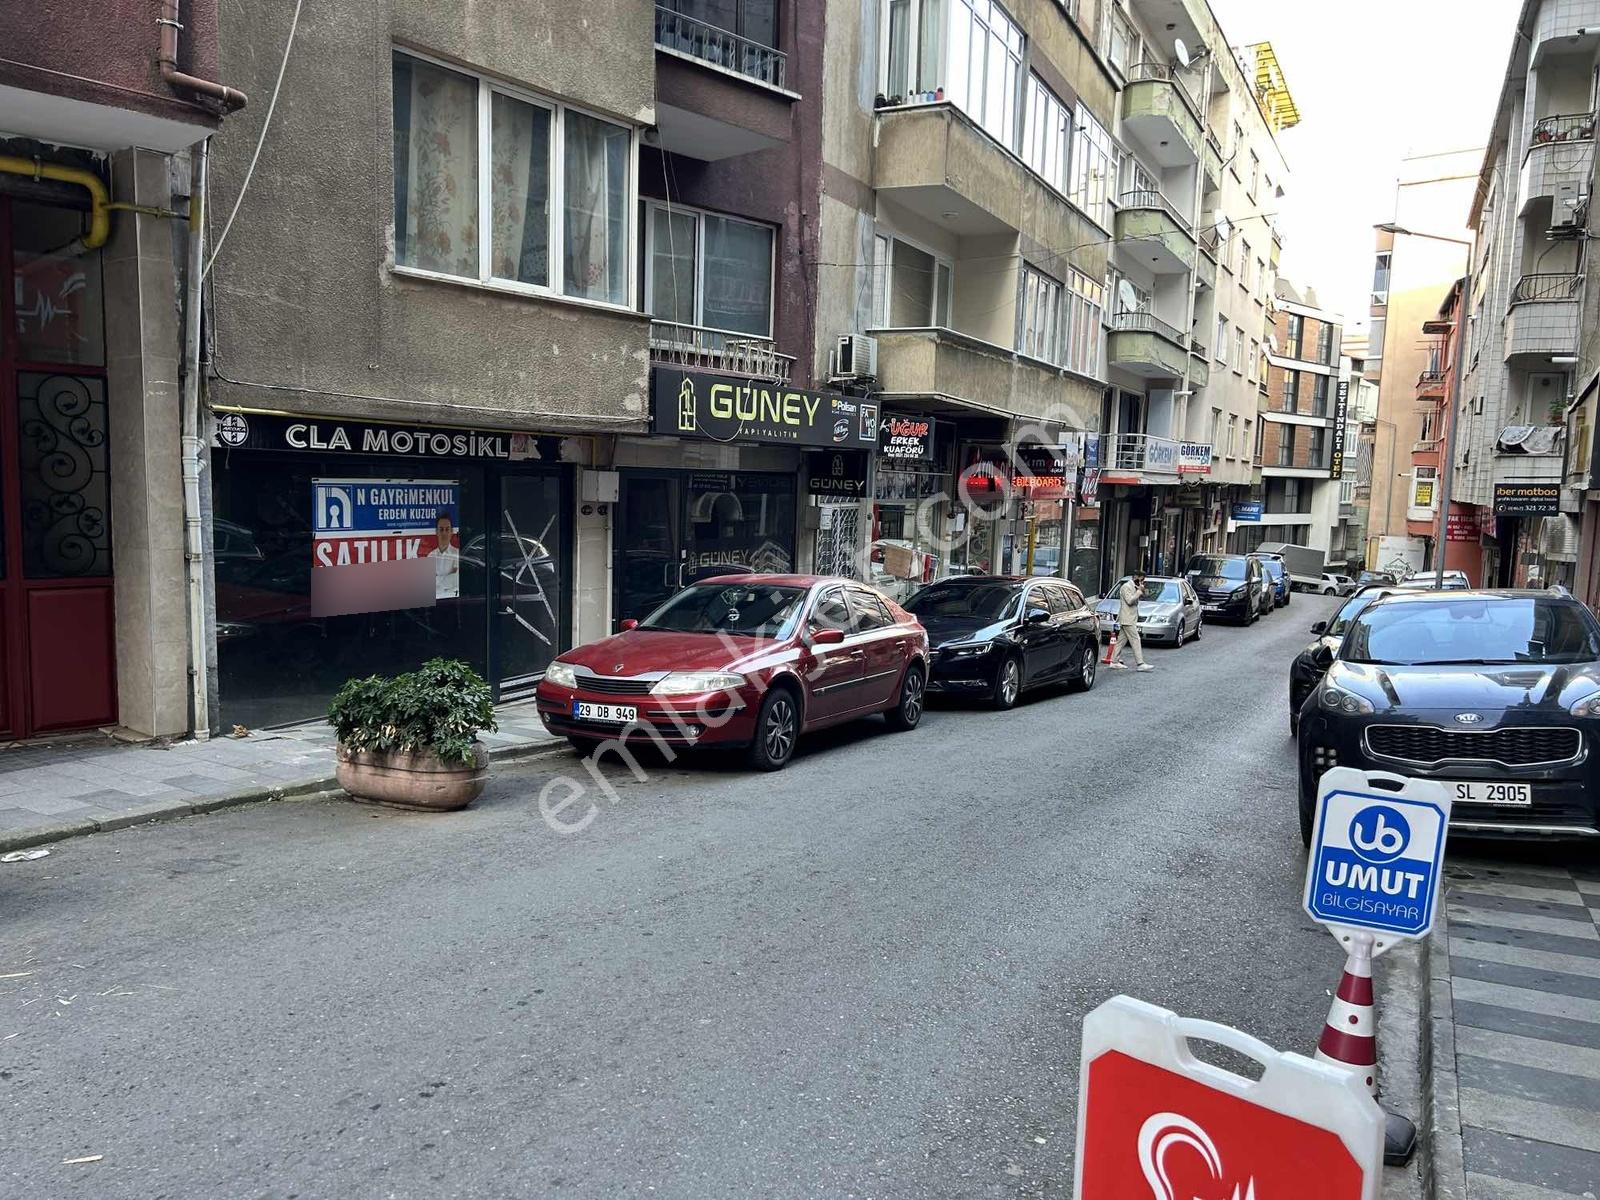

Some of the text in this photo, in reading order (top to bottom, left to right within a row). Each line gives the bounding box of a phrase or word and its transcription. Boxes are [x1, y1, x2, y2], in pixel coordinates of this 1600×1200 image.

[710, 383, 821, 426] GÜNEY
[285, 424, 352, 450] CLA
[890, 436, 919, 445] ERKEK
[883, 444, 924, 454] KUAFÖRÜ
[1180, 443, 1211, 456] GÖRKEM
[1333, 452, 1341, 478] OTEL
[809, 478, 865, 490] GÜNEY
[1517, 487, 1558, 496] matbaa
[357, 488, 365, 506] N
[378, 508, 437, 520] ERDEM KUZUR
[579, 704, 635, 720] 29 DB 949
[1456, 783, 1527, 801] SL 2905
[1325, 859, 1425, 899] UMUT
